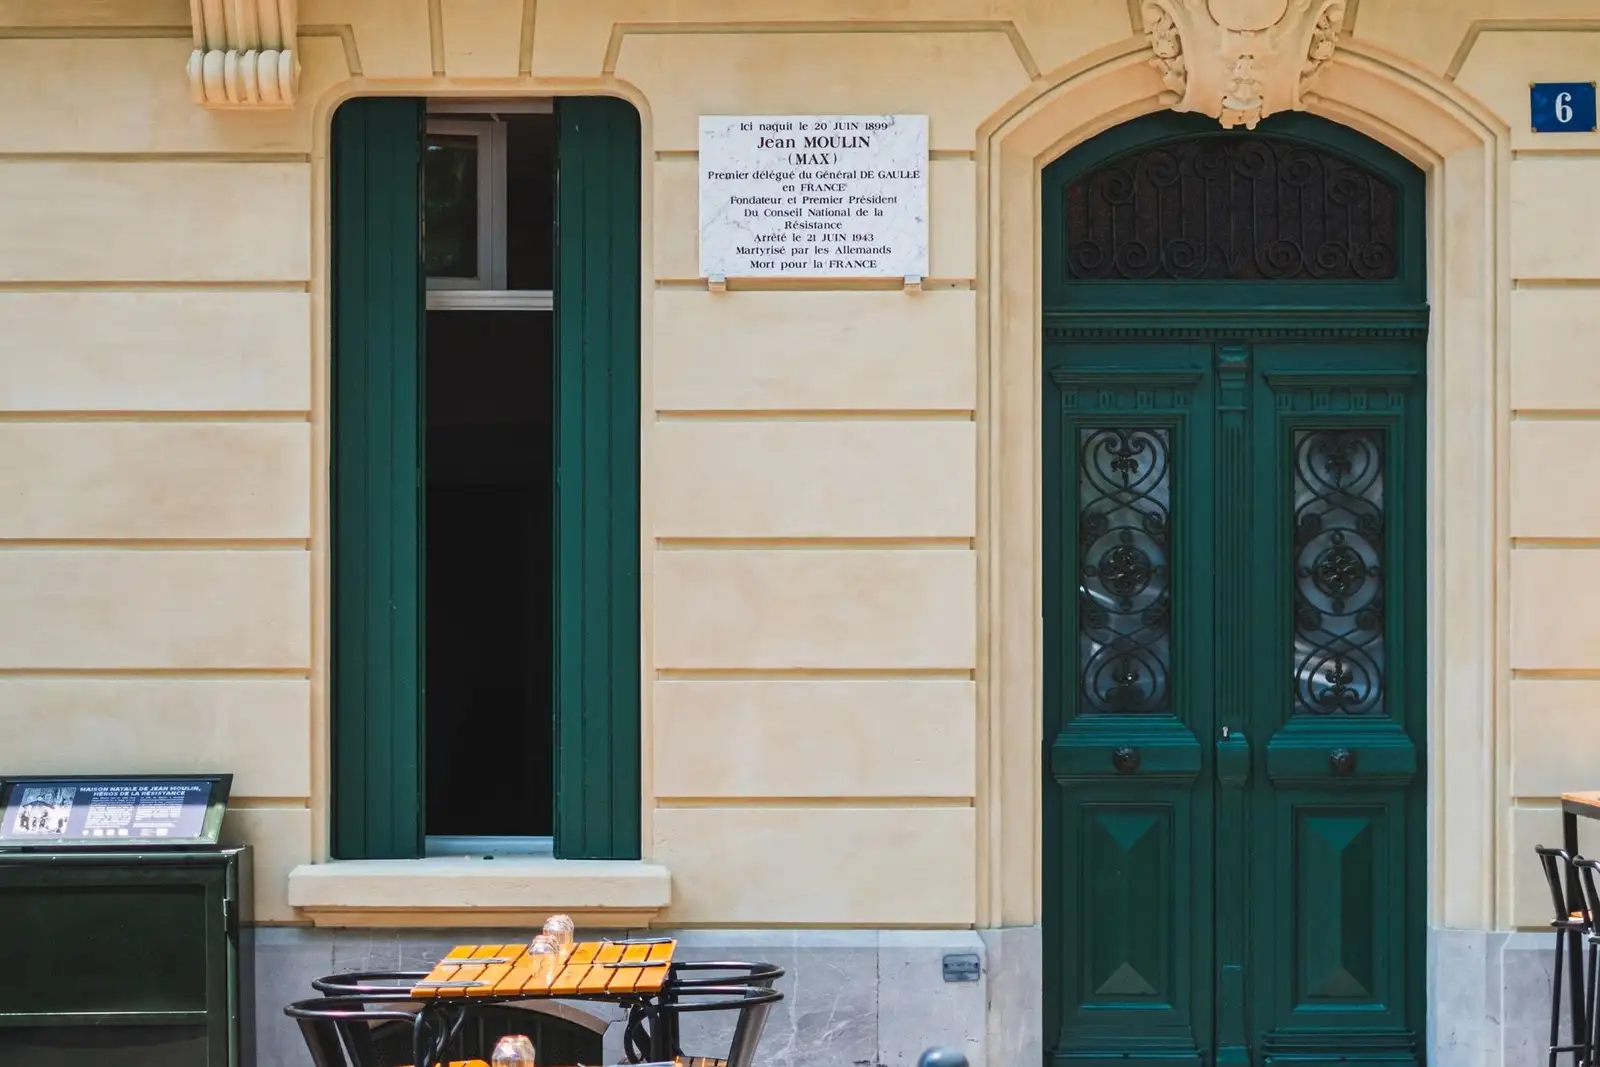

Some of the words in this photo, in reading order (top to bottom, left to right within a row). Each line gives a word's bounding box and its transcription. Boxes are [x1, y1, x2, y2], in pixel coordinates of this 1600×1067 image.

[1555, 92, 1573, 123] 6
[741, 122, 753, 131] Ici
[759, 122, 792, 133] naquit
[799, 122, 808, 131] le
[815, 123, 827, 131] 20
[833, 122, 858, 131] JUIN
[865, 122, 888, 131] 1899
[757, 137, 796, 149] Jean
[804, 137, 870, 148] MOULIN
[788, 153, 837, 165] (MAX)
[753, 171, 795, 181] délégué
[799, 171, 812, 179] du
[816, 170, 856, 179] Général
[860, 171, 874, 179] DE
[878, 171, 920, 179] GAULLE
[730, 196, 781, 204] Fondateur
[787, 196, 797, 204] et
[802, 196, 843, 204] Premier
[849, 196, 897, 204] Président
[744, 209, 758, 217] Du
[764, 208, 802, 217] Conseil
[808, 208, 850, 217] National
[856, 208, 869, 216] de
[874, 208, 883, 216] la
[785, 221, 842, 229] Résistance
[754, 233, 787, 242] Arrêté
[792, 233, 801, 242] le
[807, 234, 816, 242] 21
[822, 233, 846, 242] JUIN
[852, 233, 874, 242] 1943
[736, 246, 786, 256] Martyrisé
[791, 247, 809, 256] par
[814, 246, 828, 254] les
[835, 245, 892, 254] Allemands
[750, 260, 774, 269] Mort
[780, 261, 807, 270] pour
[813, 260, 823, 268] la
[829, 260, 877, 268] FRANCE
